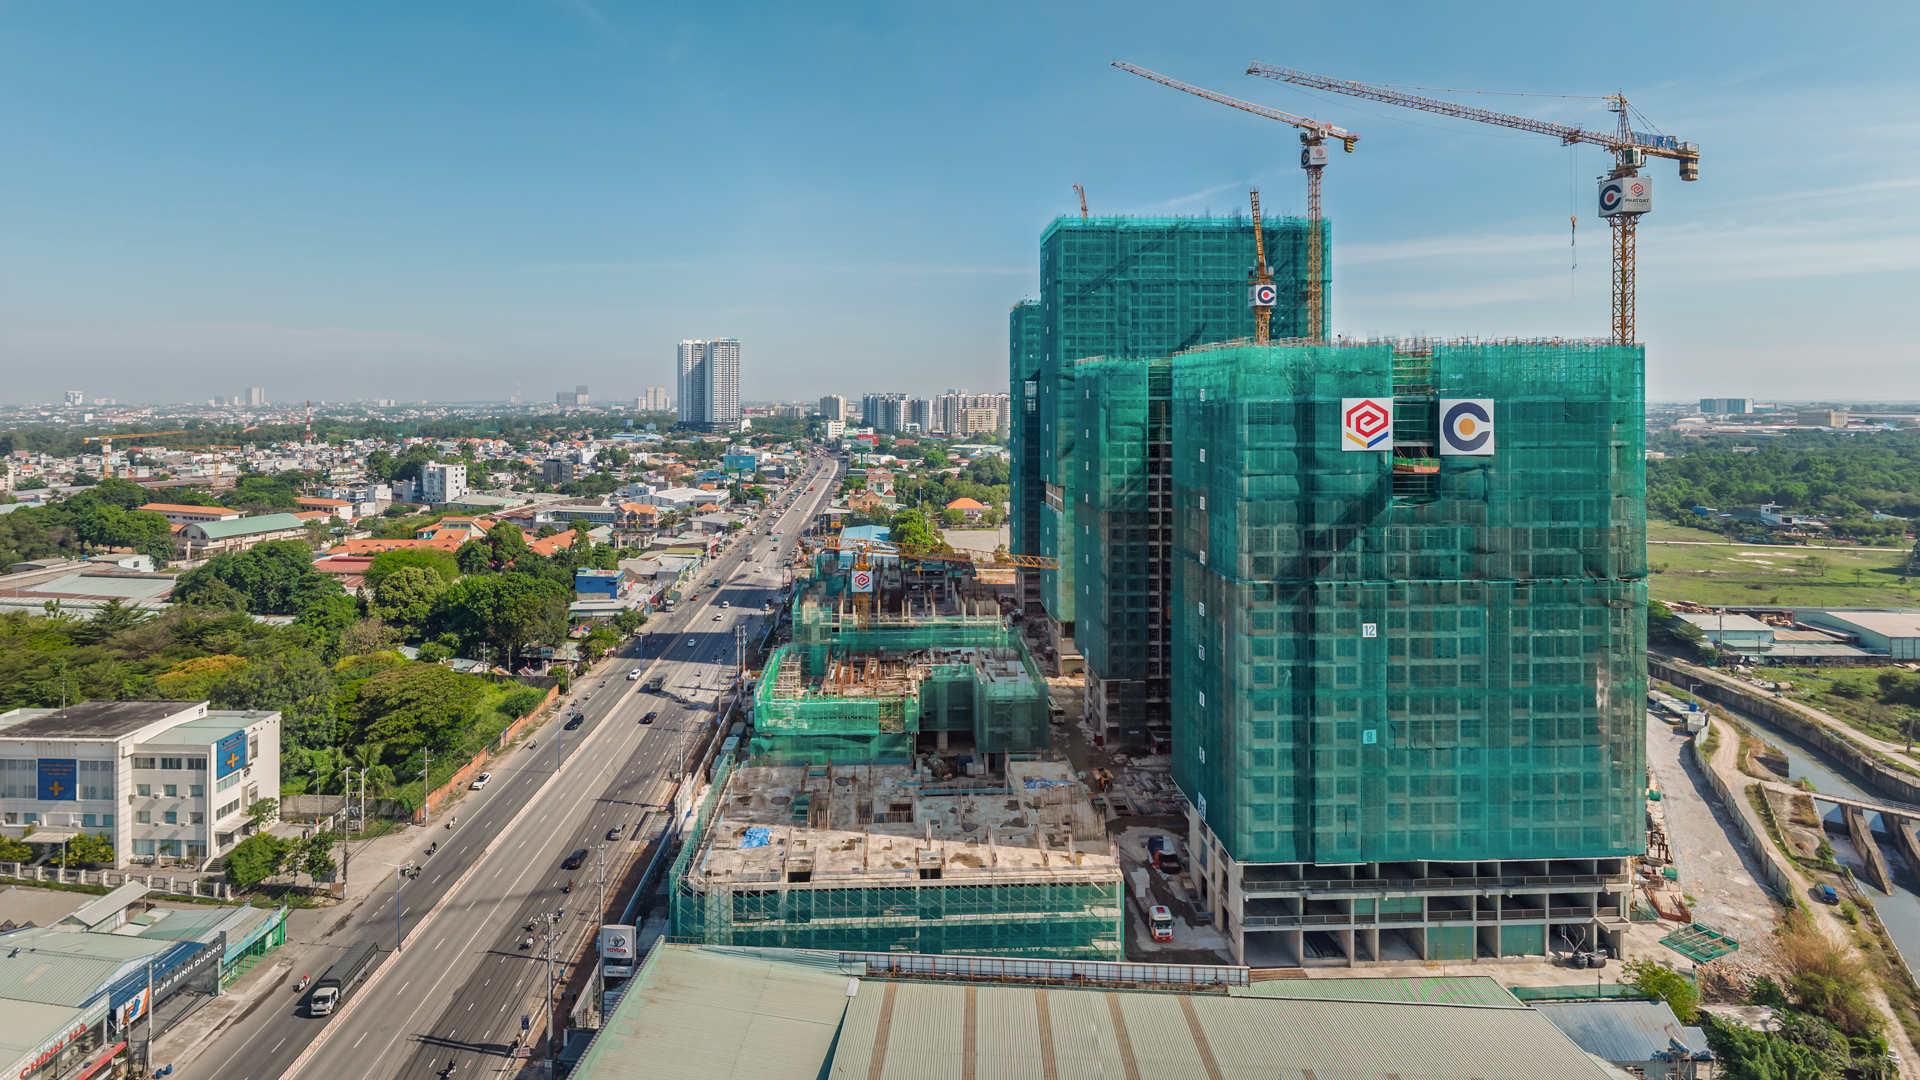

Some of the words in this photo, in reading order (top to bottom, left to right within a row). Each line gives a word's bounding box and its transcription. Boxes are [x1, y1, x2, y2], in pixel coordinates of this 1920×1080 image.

[1634, 132, 1678, 148] CENTRAL
[1364, 625, 1375, 636] 12
[1366, 731, 1372, 742] 8
